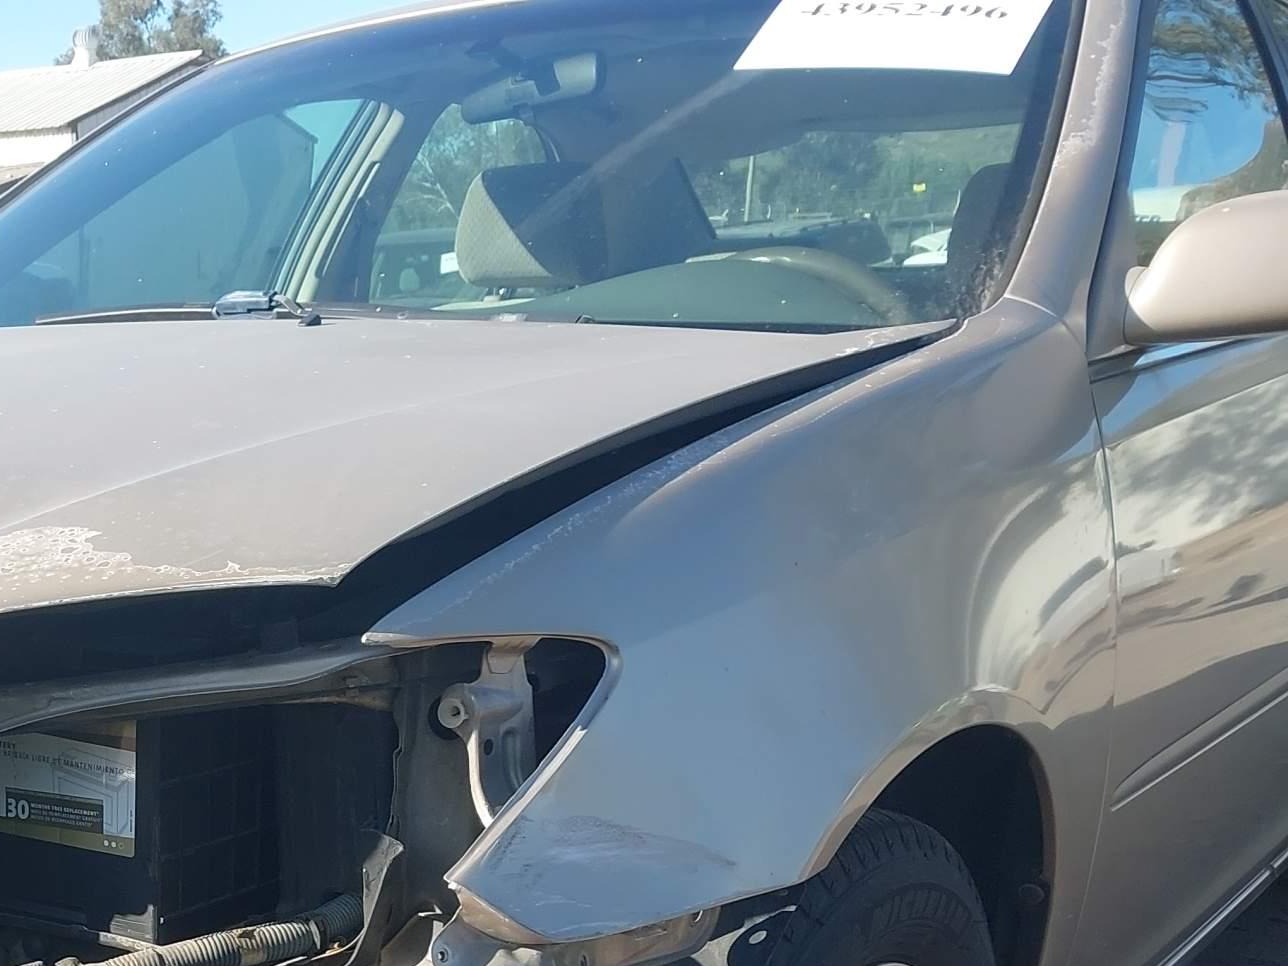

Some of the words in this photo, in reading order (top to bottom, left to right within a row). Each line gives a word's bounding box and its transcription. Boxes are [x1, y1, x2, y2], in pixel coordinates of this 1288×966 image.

[801, 2, 1008, 19] 43952496
[63, 759, 125, 775] MANTENIMIENTO
[7, 798, 30, 820] 30
